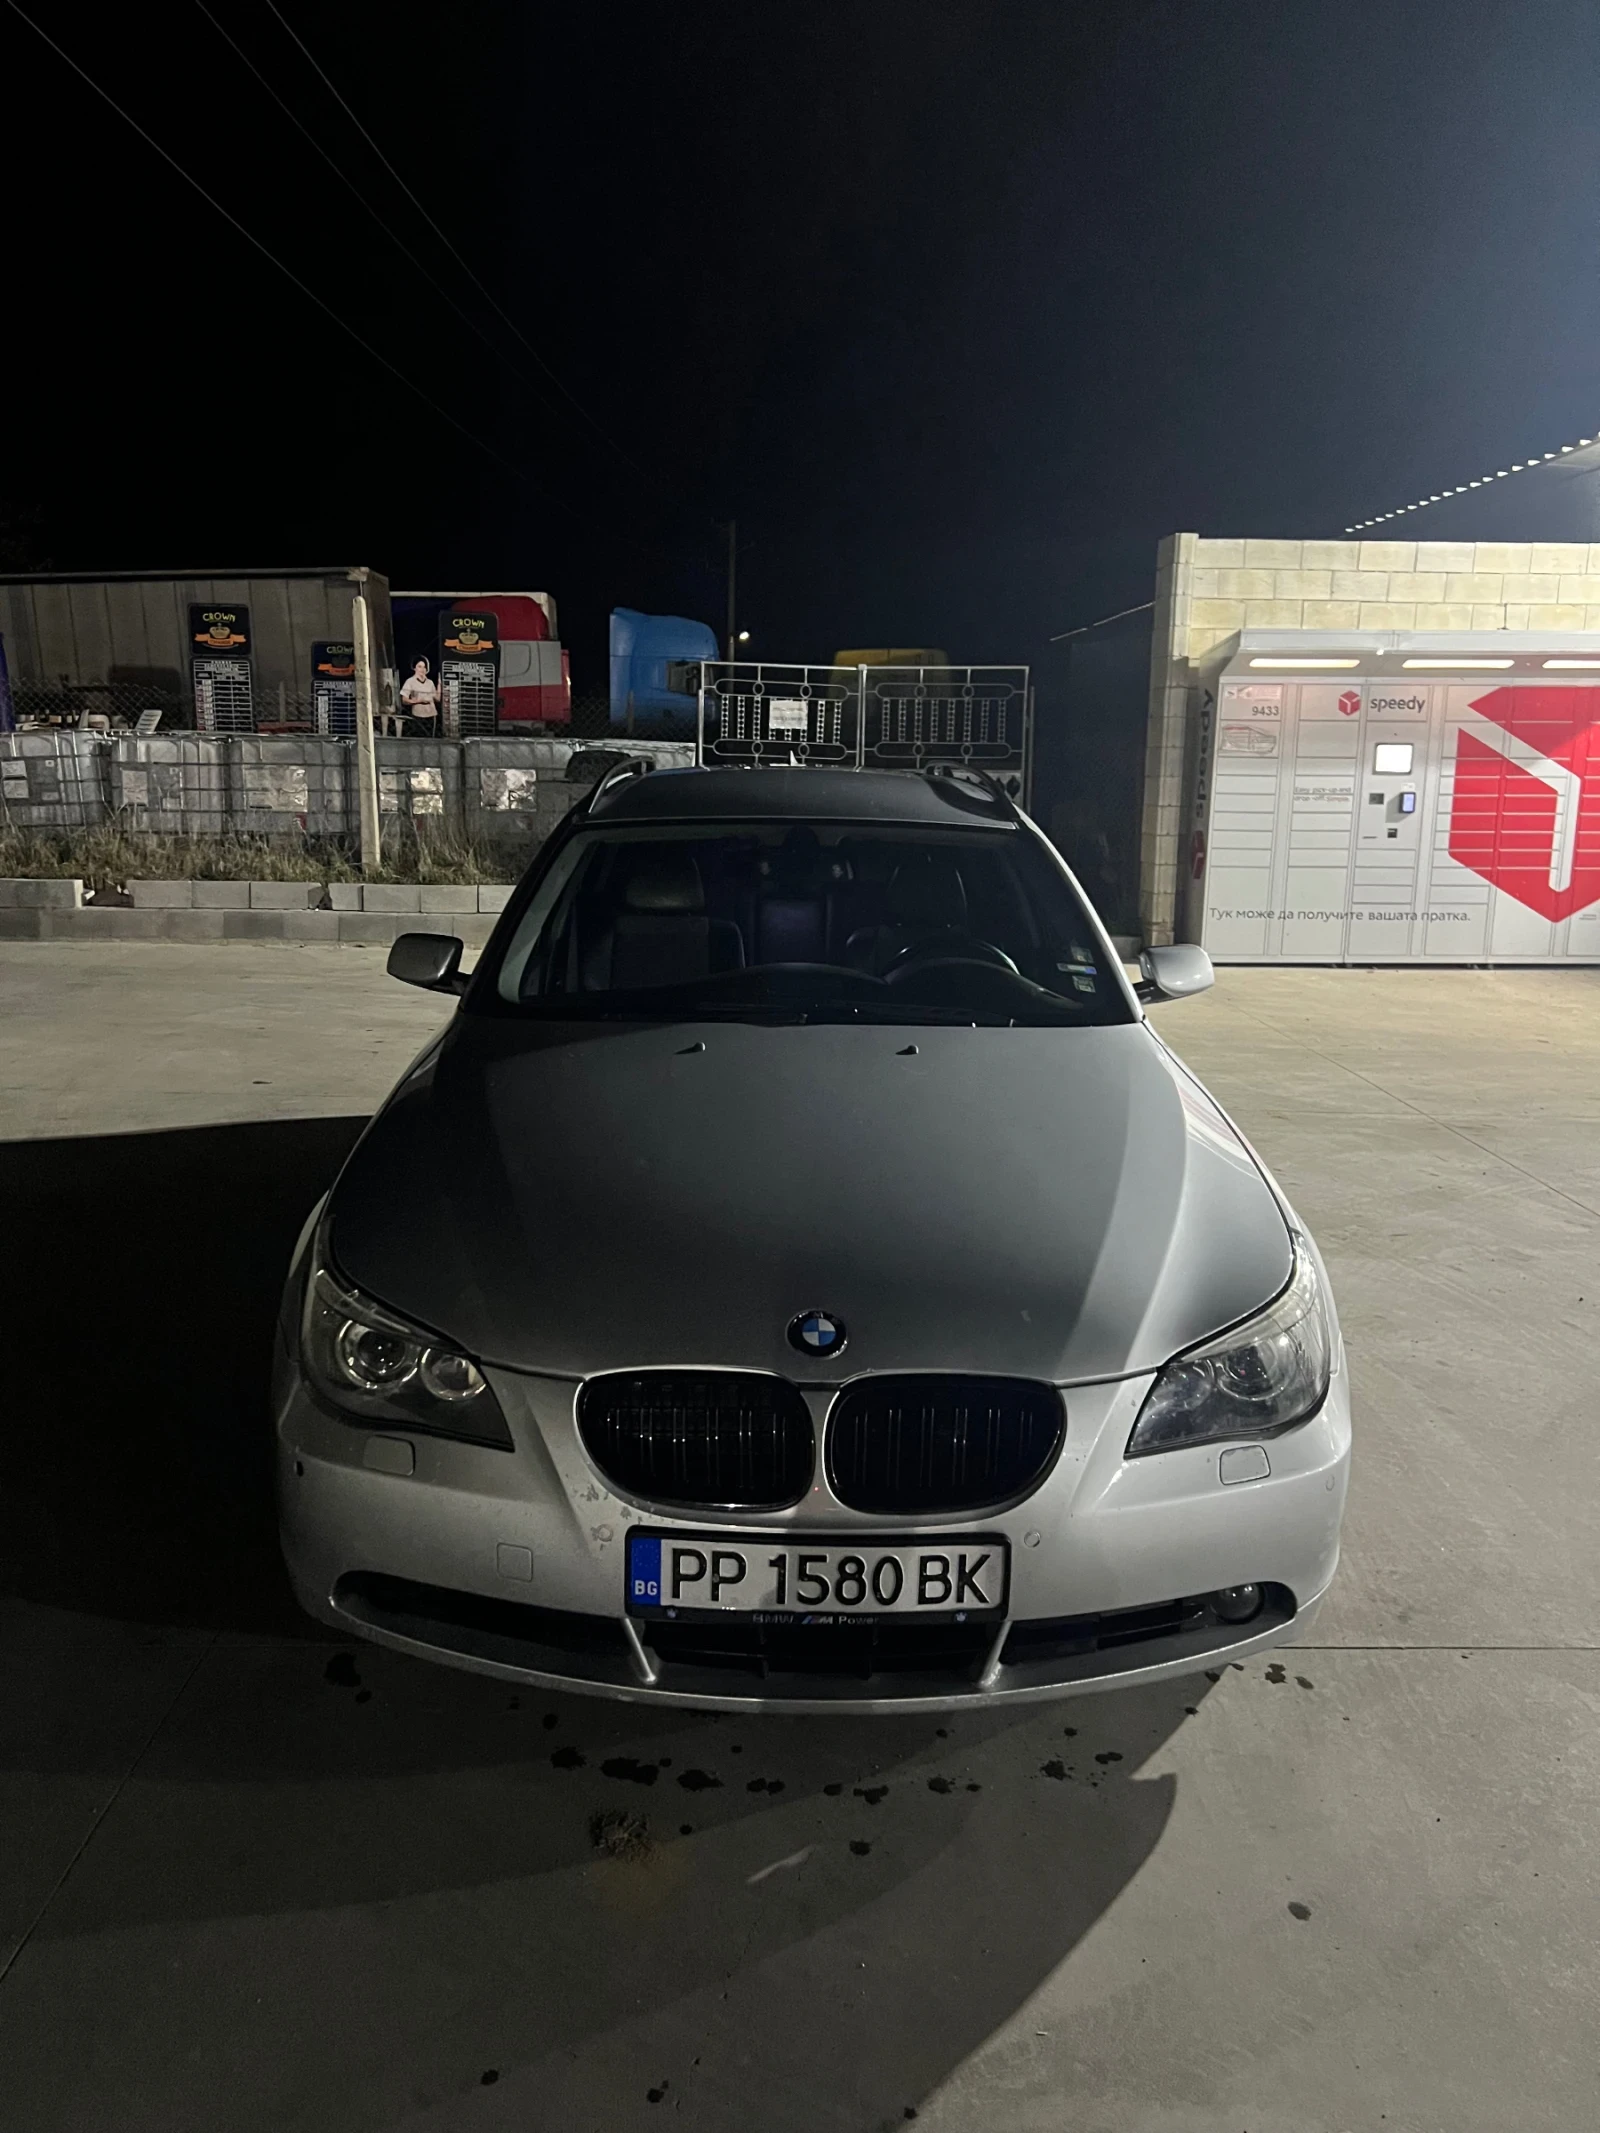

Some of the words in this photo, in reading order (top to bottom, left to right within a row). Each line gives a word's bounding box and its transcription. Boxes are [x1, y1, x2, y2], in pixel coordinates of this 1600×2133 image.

[202, 612, 236, 622] CROWN
[452, 618, 485, 628] CROWN
[1370, 695, 1426, 713] speedy
[1251, 706, 1280, 717] 9433
[1209, 907, 1233, 921] Тук
[1236, 910, 1275, 920] може
[1277, 910, 1294, 921] да
[1297, 910, 1364, 922] получите
[1368, 911, 1418, 921] вашата
[1421, 911, 1471, 923] пратка.
[671, 1547, 747, 1602] PP
[768, 1553, 904, 1606] 1580
[917, 1553, 991, 1604] BK
[634, 1580, 658, 1596] BG
[838, 1615, 879, 1625] Power
